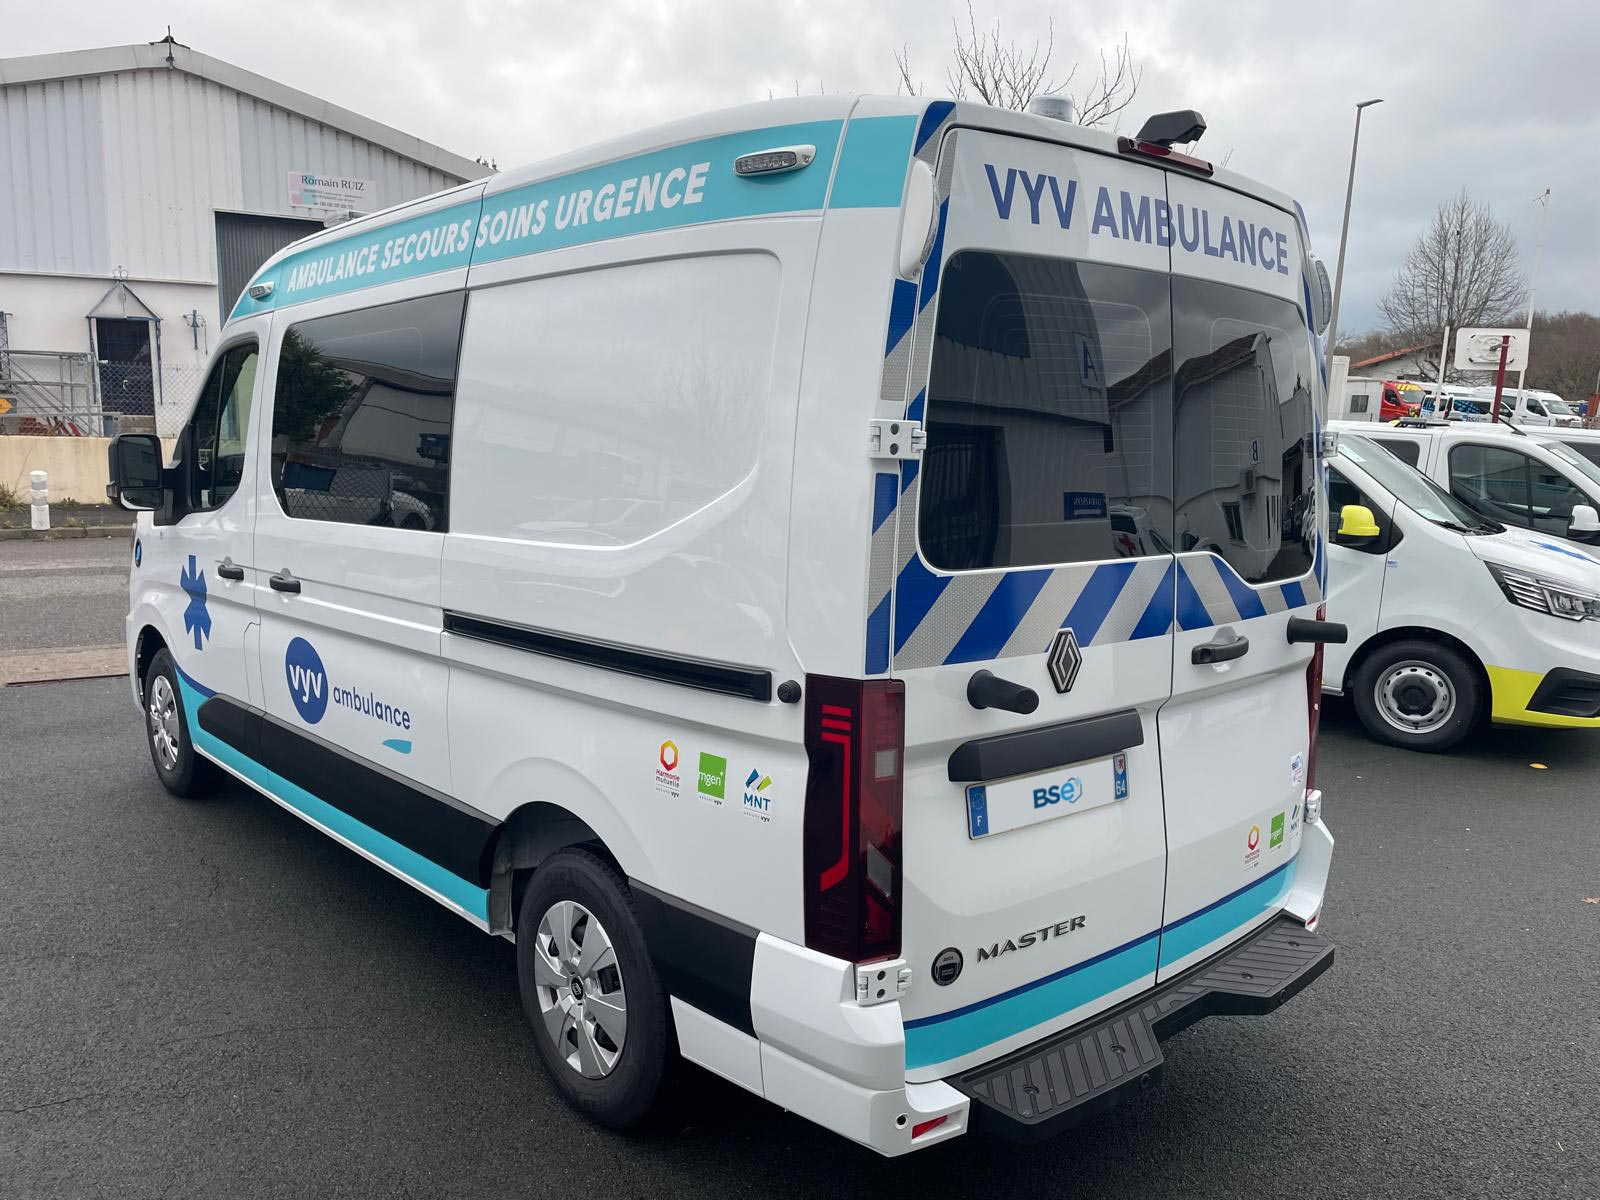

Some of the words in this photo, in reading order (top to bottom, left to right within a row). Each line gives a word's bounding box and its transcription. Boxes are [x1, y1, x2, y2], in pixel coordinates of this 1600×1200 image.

[301, 175, 339, 189] Romain
[341, 179, 365, 192] RUIZ
[287, 243, 379, 293] AMBULANCE
[381, 218, 472, 270] SECOURS
[475, 199, 549, 248] SOINS
[554, 161, 711, 231] URGENCE
[984, 163, 1077, 230] VYV
[1091, 186, 1289, 275] AMBULANCE
[289, 664, 322, 704] vyv
[333, 686, 411, 730] ambulance
[656, 768, 680, 782] Harmonie
[1115, 780, 1127, 796] 64
[744, 792, 771, 811] MNT
[976, 815, 983, 828] F
[977, 914, 1086, 963] MASTER
